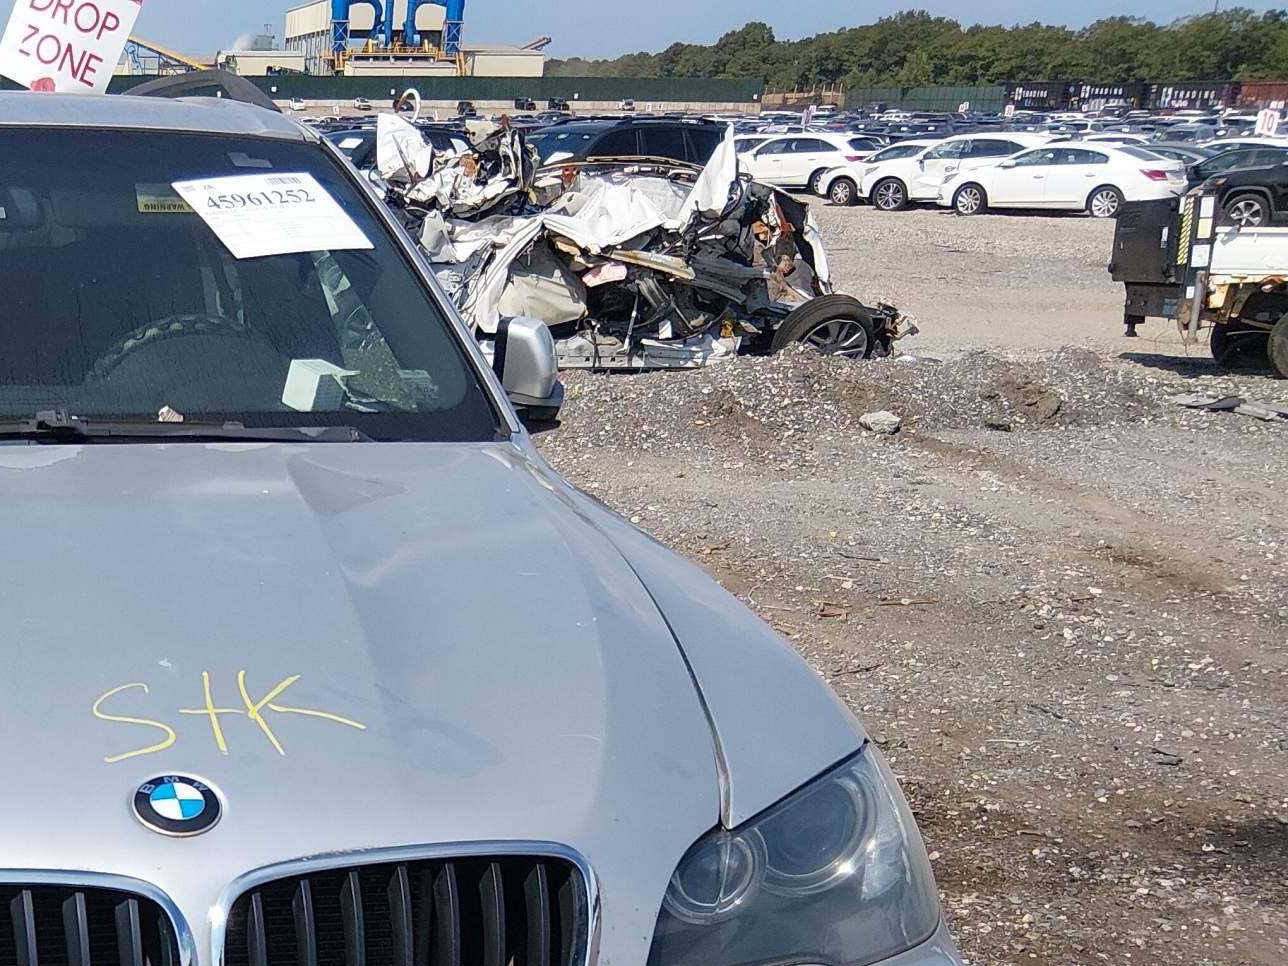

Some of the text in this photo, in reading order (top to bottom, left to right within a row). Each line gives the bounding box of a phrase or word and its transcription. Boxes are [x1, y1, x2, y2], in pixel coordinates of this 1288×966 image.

[18, 24, 103, 88] ZONE
[144, 203, 185, 211] WARNING
[207, 188, 316, 209] 45961252
[138, 776, 209, 795] BMW
